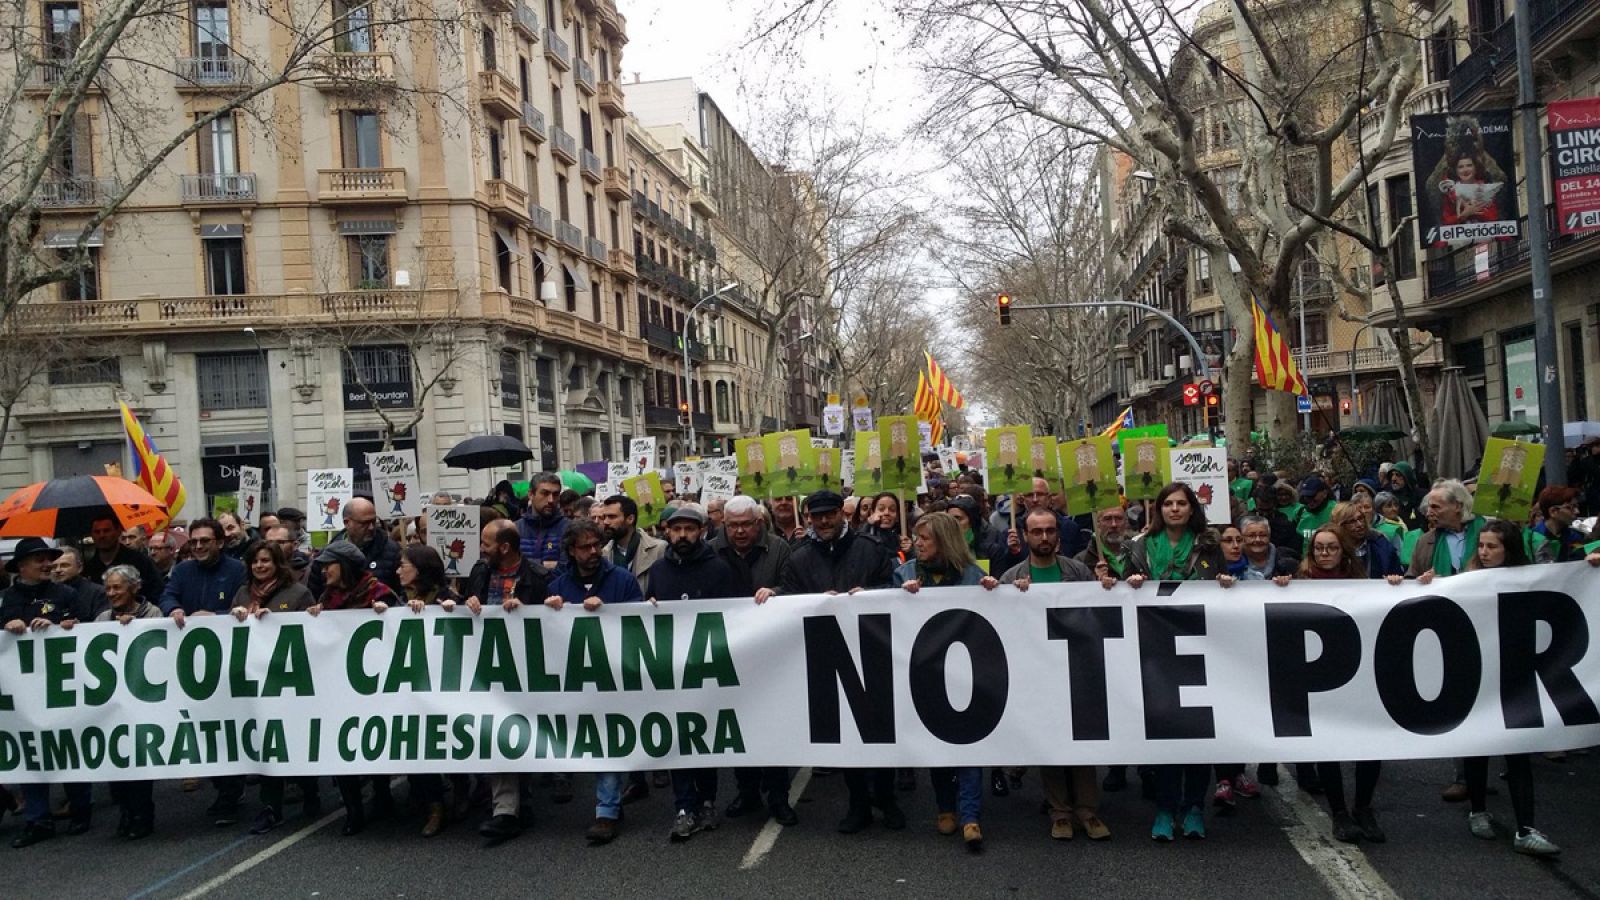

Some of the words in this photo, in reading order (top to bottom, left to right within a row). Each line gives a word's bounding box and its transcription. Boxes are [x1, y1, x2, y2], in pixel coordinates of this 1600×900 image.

[349, 392, 366, 401] Best
[346, 611, 741, 696] CATALANA
[803, 607, 1009, 745] NO
[1046, 582, 1217, 742] TÉ
[1264, 590, 1600, 738] POR
[0, 709, 289, 771] DEMOCRÀTICA
[308, 718, 321, 762] I
[338, 708, 746, 762] COHESIONADORA
